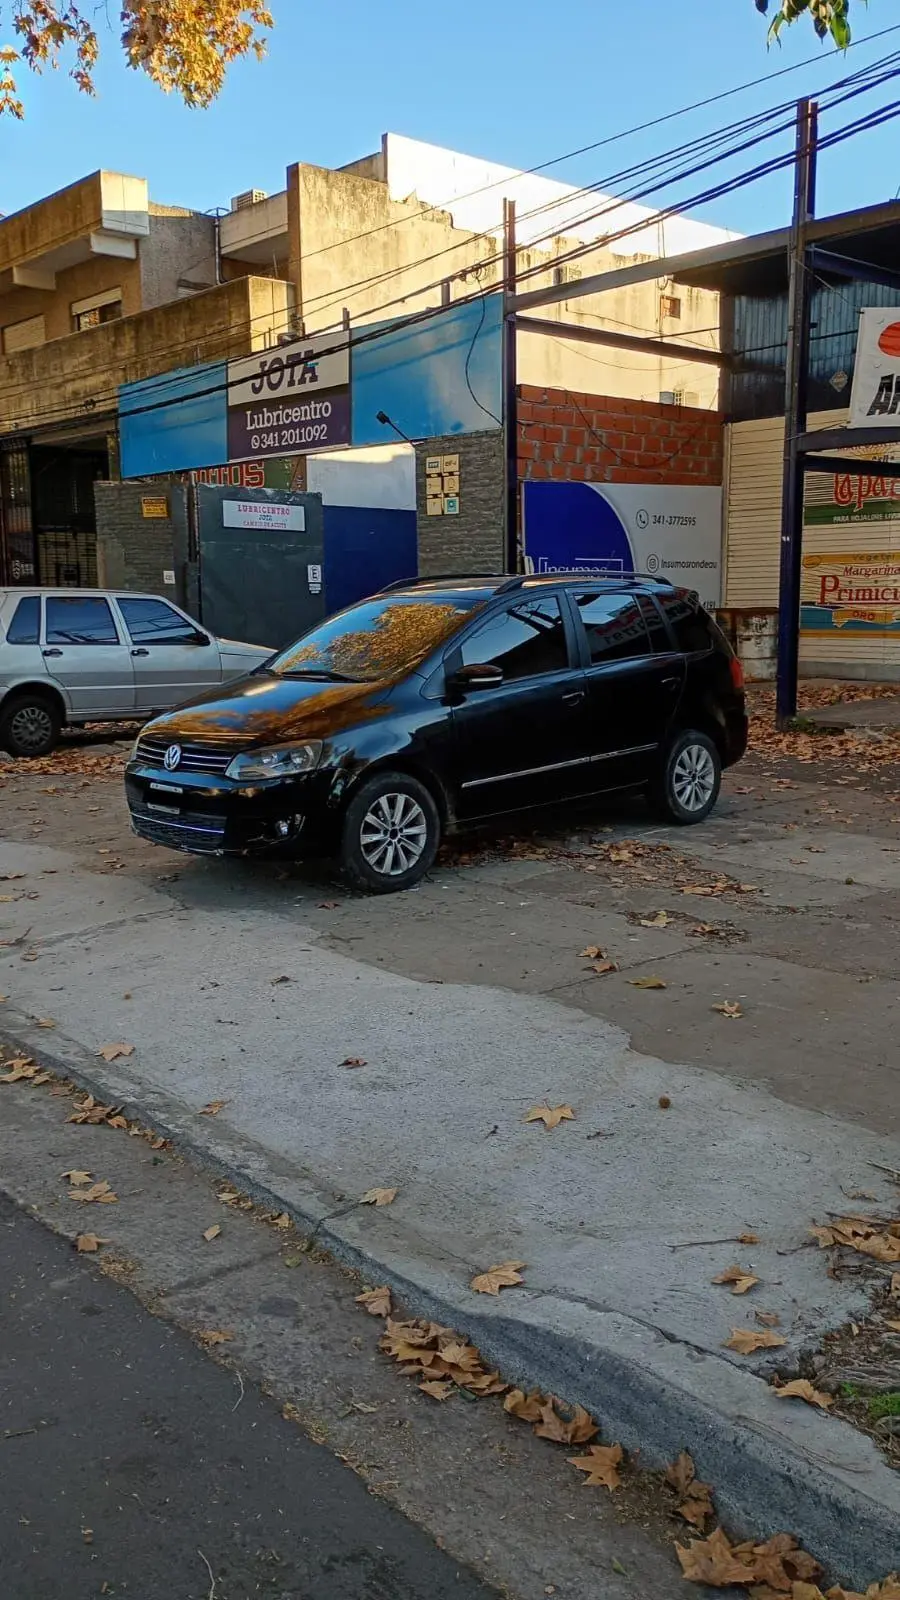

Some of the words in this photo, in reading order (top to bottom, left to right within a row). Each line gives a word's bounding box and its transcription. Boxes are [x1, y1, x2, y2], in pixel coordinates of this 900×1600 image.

[251, 349, 319, 394] JOTA
[246, 401, 332, 430] Lubricentro
[261, 432, 280, 448] 341
[281, 424, 328, 446] 2011092
[238, 504, 290, 516] LUBRICENTRO
[818, 575, 900, 604] Primici
[852, 610, 876, 620] ORO
